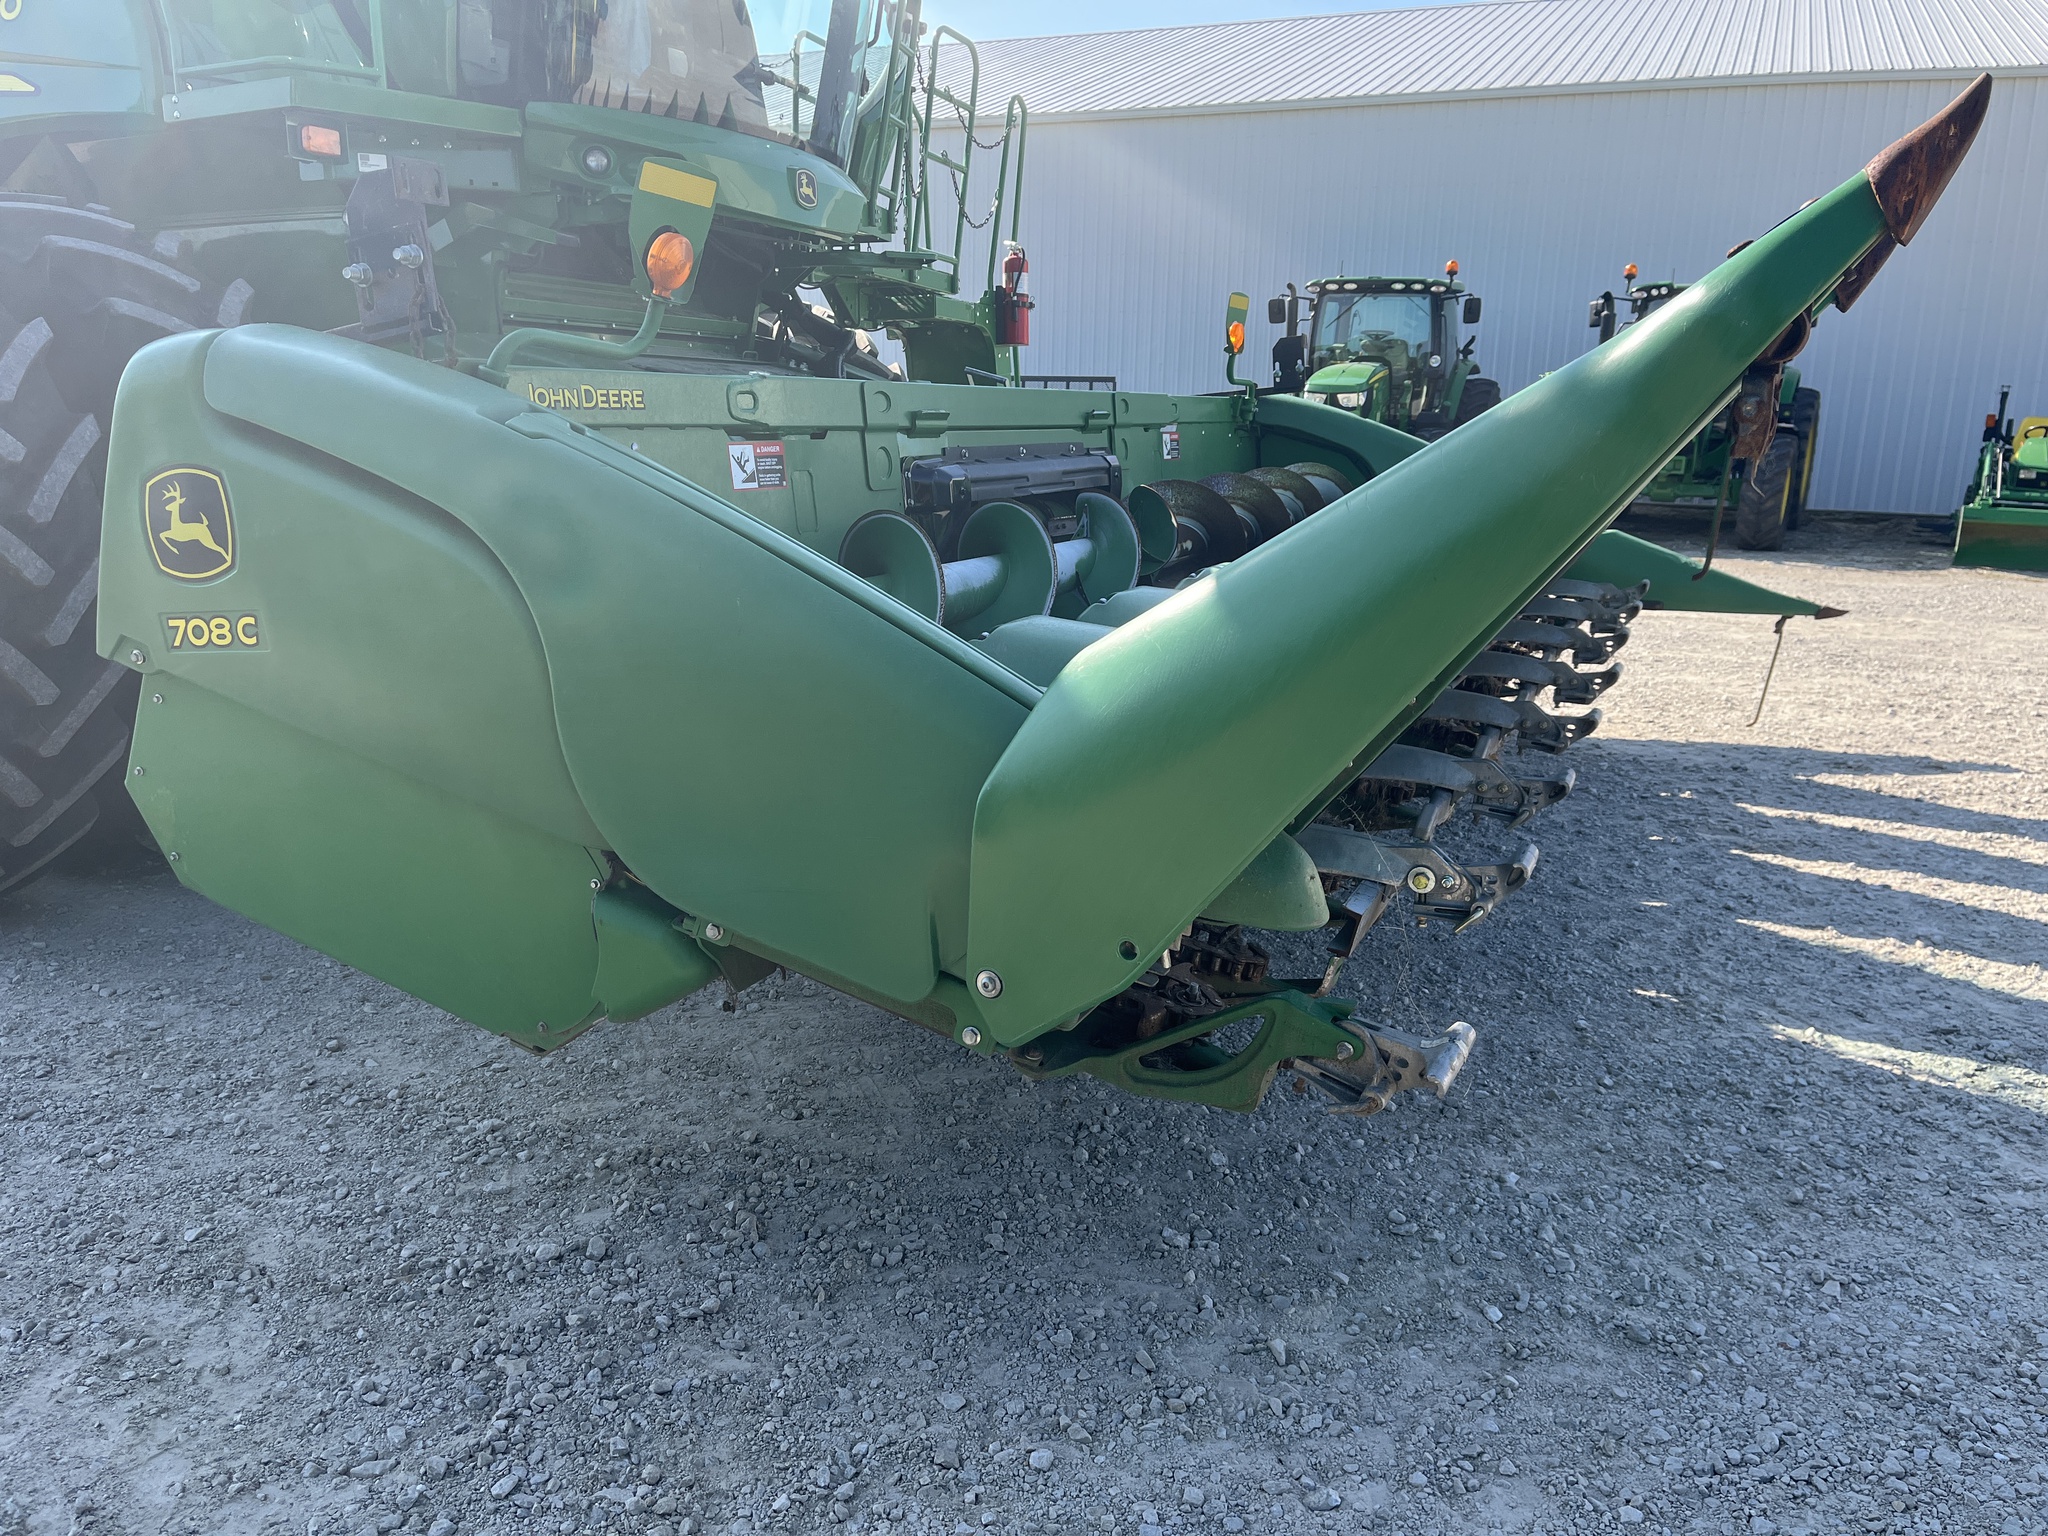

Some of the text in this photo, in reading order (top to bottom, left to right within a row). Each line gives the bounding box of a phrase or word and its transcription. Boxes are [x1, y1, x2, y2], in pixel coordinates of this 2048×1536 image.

[528, 383, 645, 410] JOHN DEERE
[760, 445, 780, 453] DANGER
[167, 616, 258, 647] 708 C
